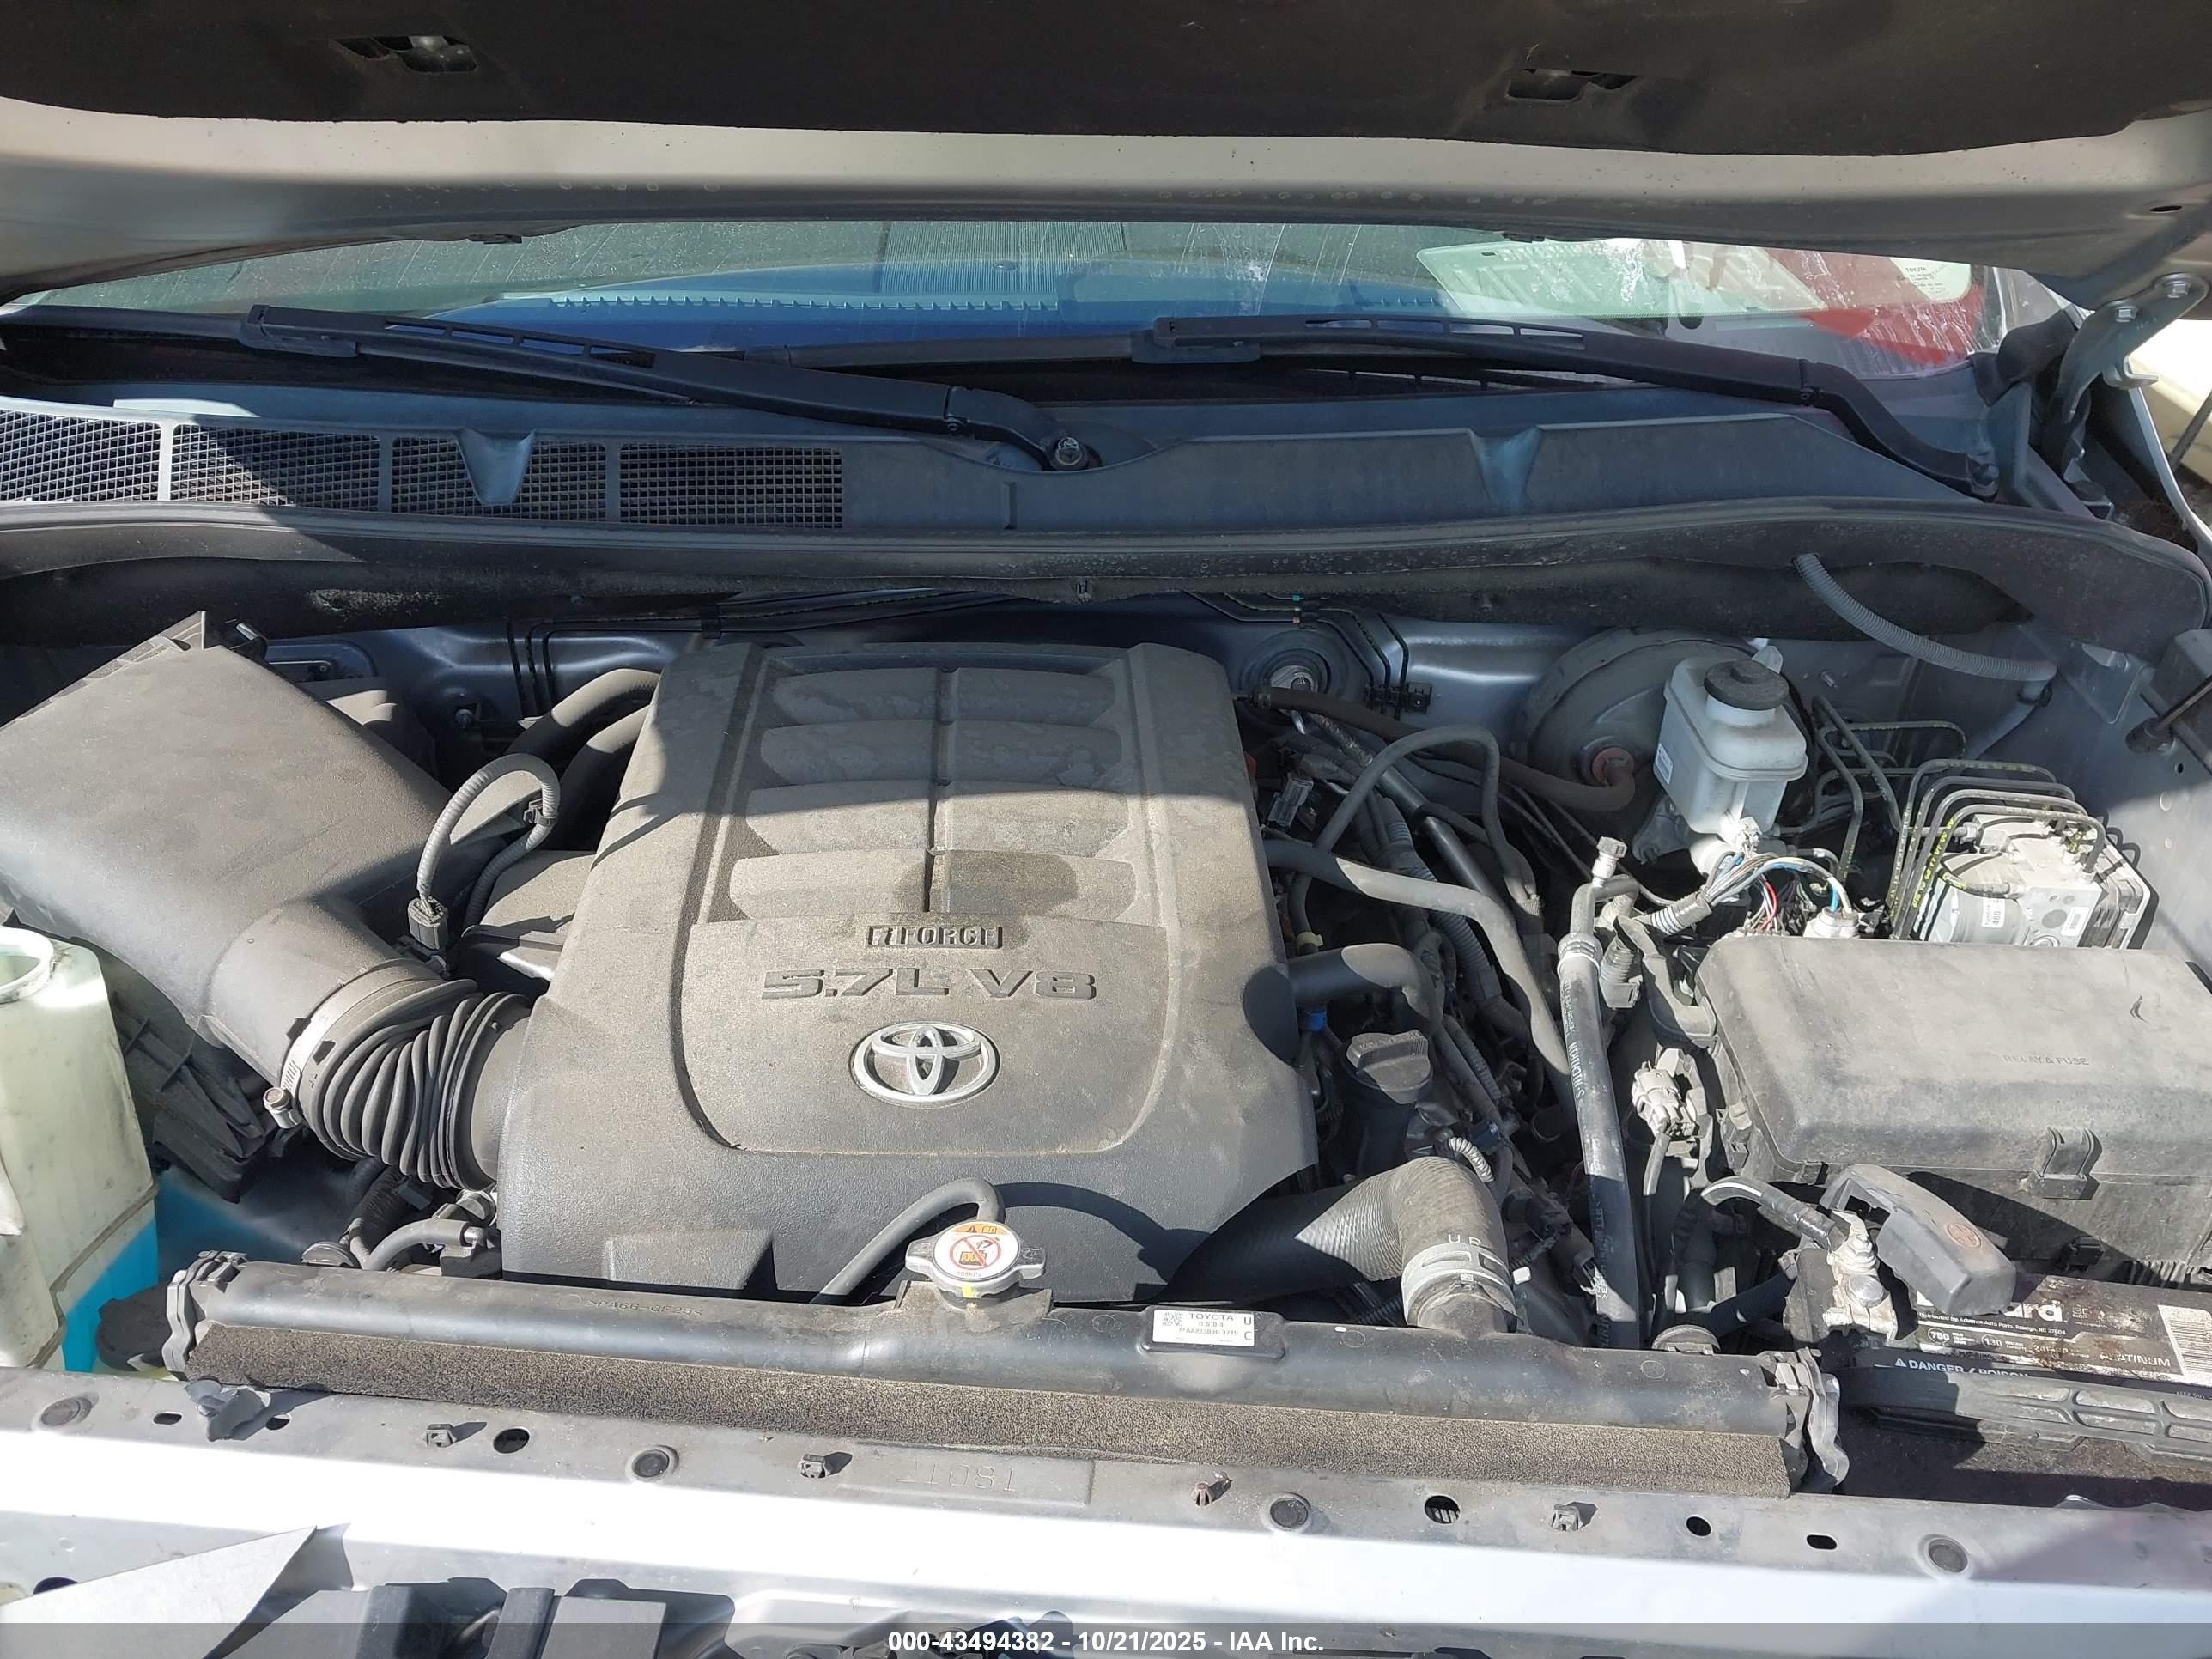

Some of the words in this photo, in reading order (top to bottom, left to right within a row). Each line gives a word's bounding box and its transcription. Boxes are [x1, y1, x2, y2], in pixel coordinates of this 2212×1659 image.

[761, 968, 950, 999] 5.7L
[969, 968, 1097, 1000] V8
[1190, 1312, 1234, 1321] TOYOTA
[1243, 1316, 1252, 1325] U
[1918, 1312, 1950, 1321] Distributed
[1244, 1331, 1253, 1340] C
[1930, 1331, 1950, 1340] 750
[1984, 1338, 2002, 1347] 130
[1909, 1359, 1965, 1374] DANGER
